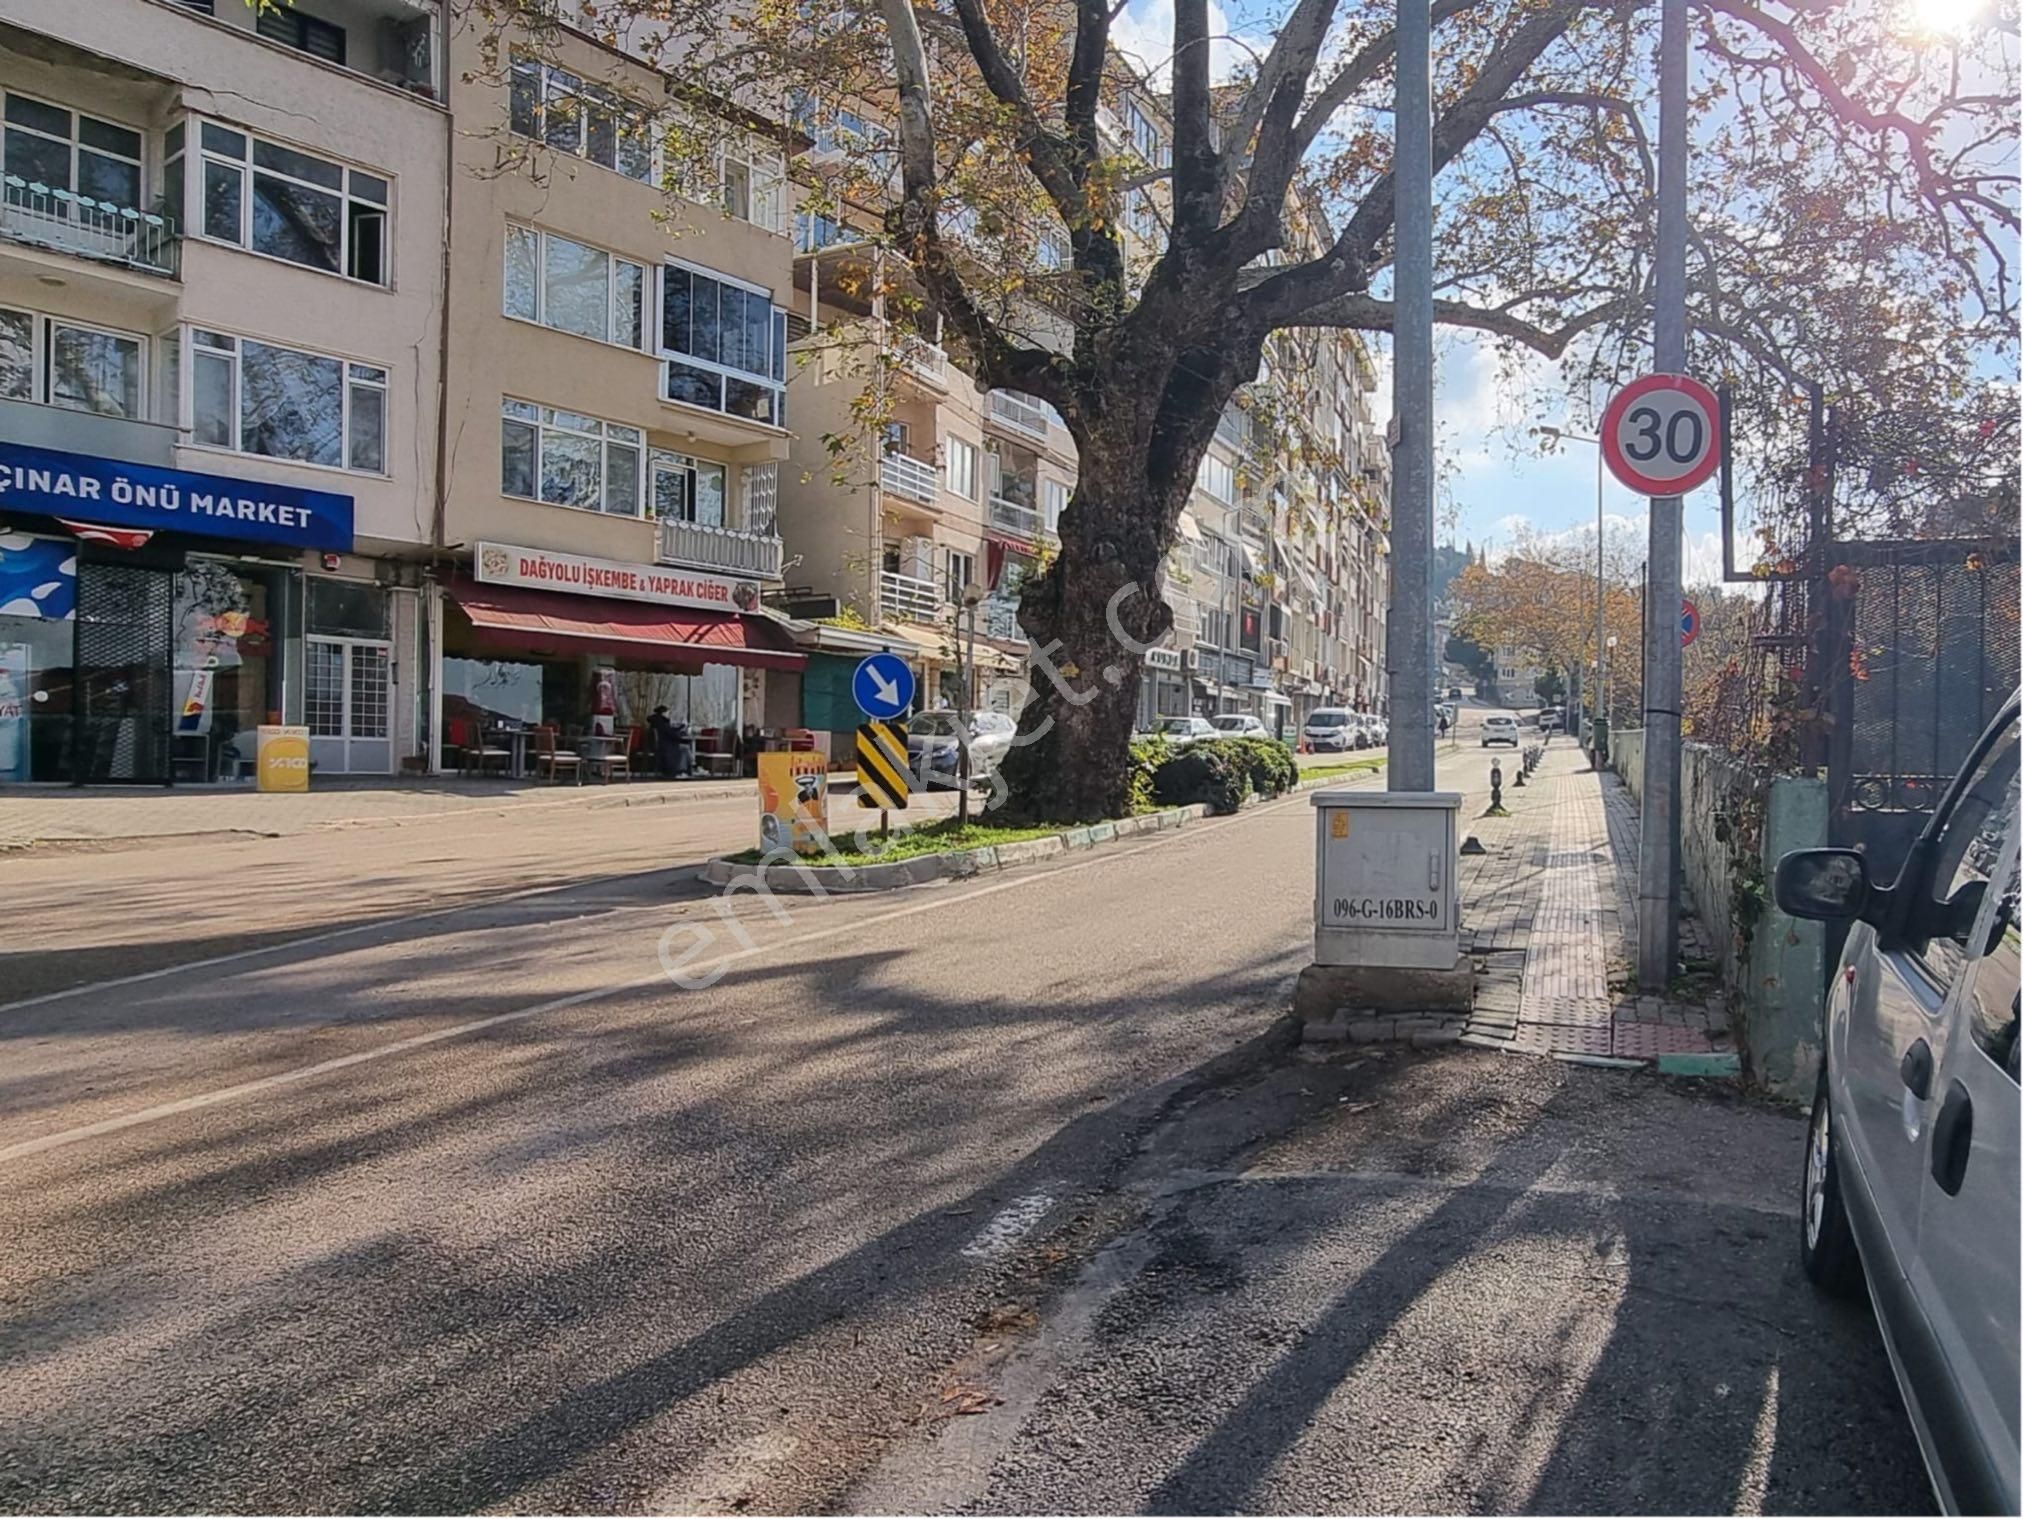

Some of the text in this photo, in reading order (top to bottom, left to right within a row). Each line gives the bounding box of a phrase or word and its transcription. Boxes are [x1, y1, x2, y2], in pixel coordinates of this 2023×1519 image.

[1625, 407, 1703, 463] 30
[0, 465, 312, 528] ÇINAR ÖNÜ MARKET
[520, 555, 729, 603] DAĞYOLU İŞKEMBE & YAPRAK CİĞER
[1334, 898, 1437, 920] 096-G-16BRS-0
